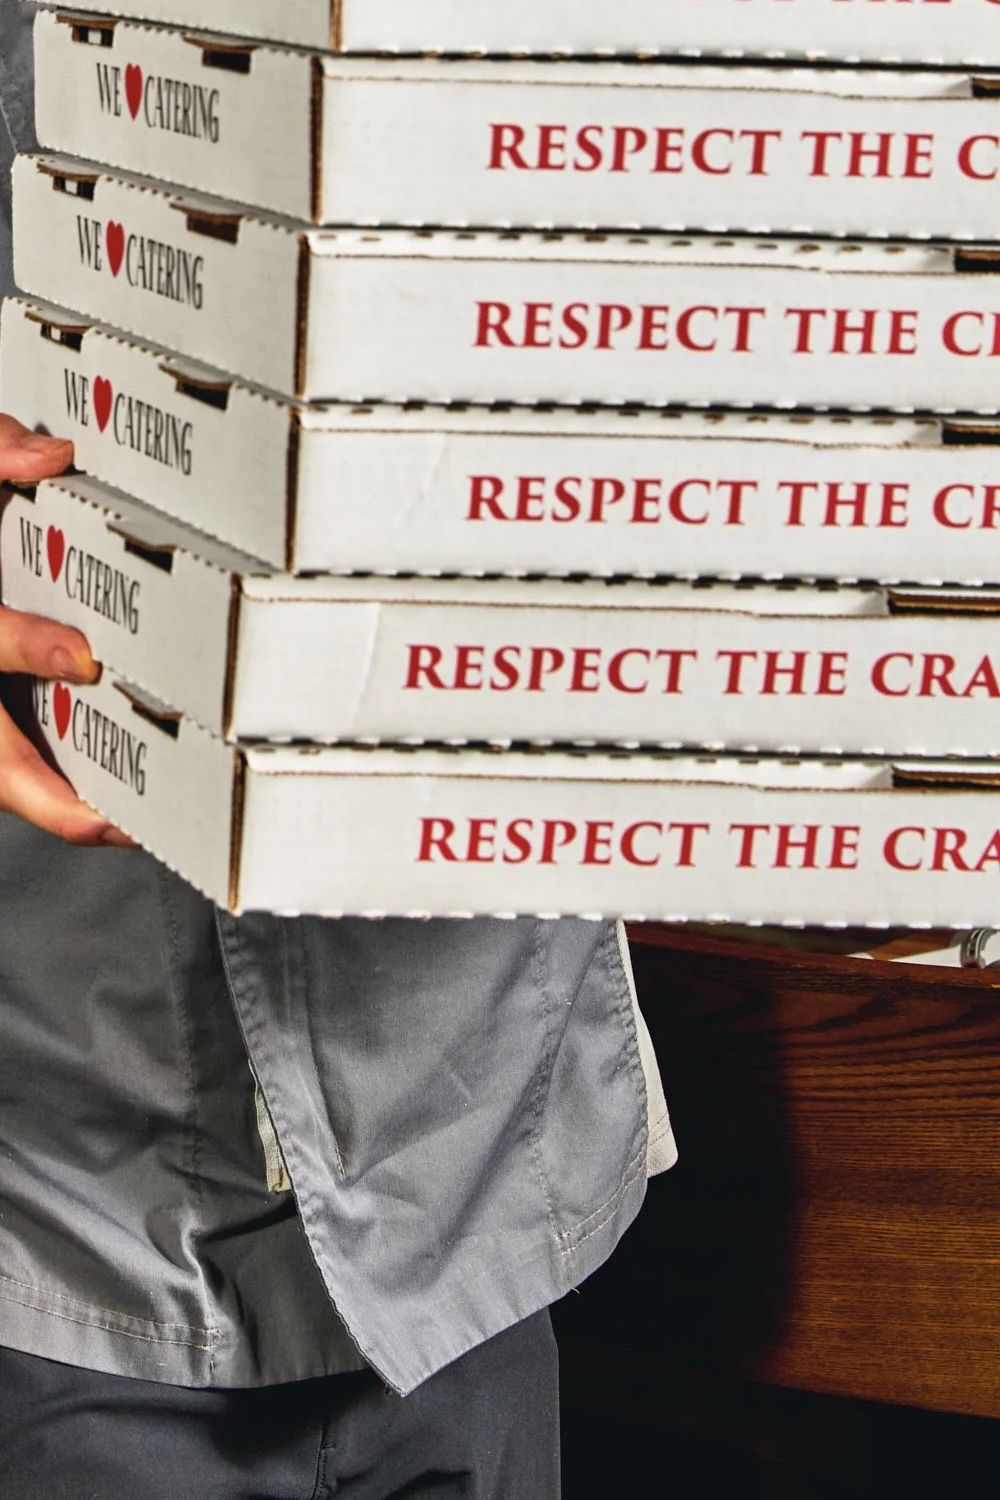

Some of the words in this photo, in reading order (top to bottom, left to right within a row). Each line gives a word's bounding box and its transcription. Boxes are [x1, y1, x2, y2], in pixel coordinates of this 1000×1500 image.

[96, 62, 121, 117] WE
[143, 75, 220, 143] CATERING
[487, 124, 781, 176] RESPECT
[801, 131, 934, 179] THE
[957, 134, 1000, 181] C
[76, 215, 102, 272] WE
[125, 234, 204, 309] CATERING
[473, 301, 765, 353] RESPECT
[785, 308, 918, 356] THE
[64, 368, 89, 426] WE
[113, 393, 193, 476] CATERING
[466, 476, 758, 525] RESPECT
[777, 481, 909, 528] THE
[20, 517, 43, 577] WE
[65, 546, 141, 635] CATERING
[402, 644, 697, 695] RESPECT
[716, 650, 849, 696] THE
[870, 652, 1000, 699] CRA
[72, 698, 147, 796] CATERING
[416, 818, 710, 868] RESPECT
[728, 823, 861, 870] THE
